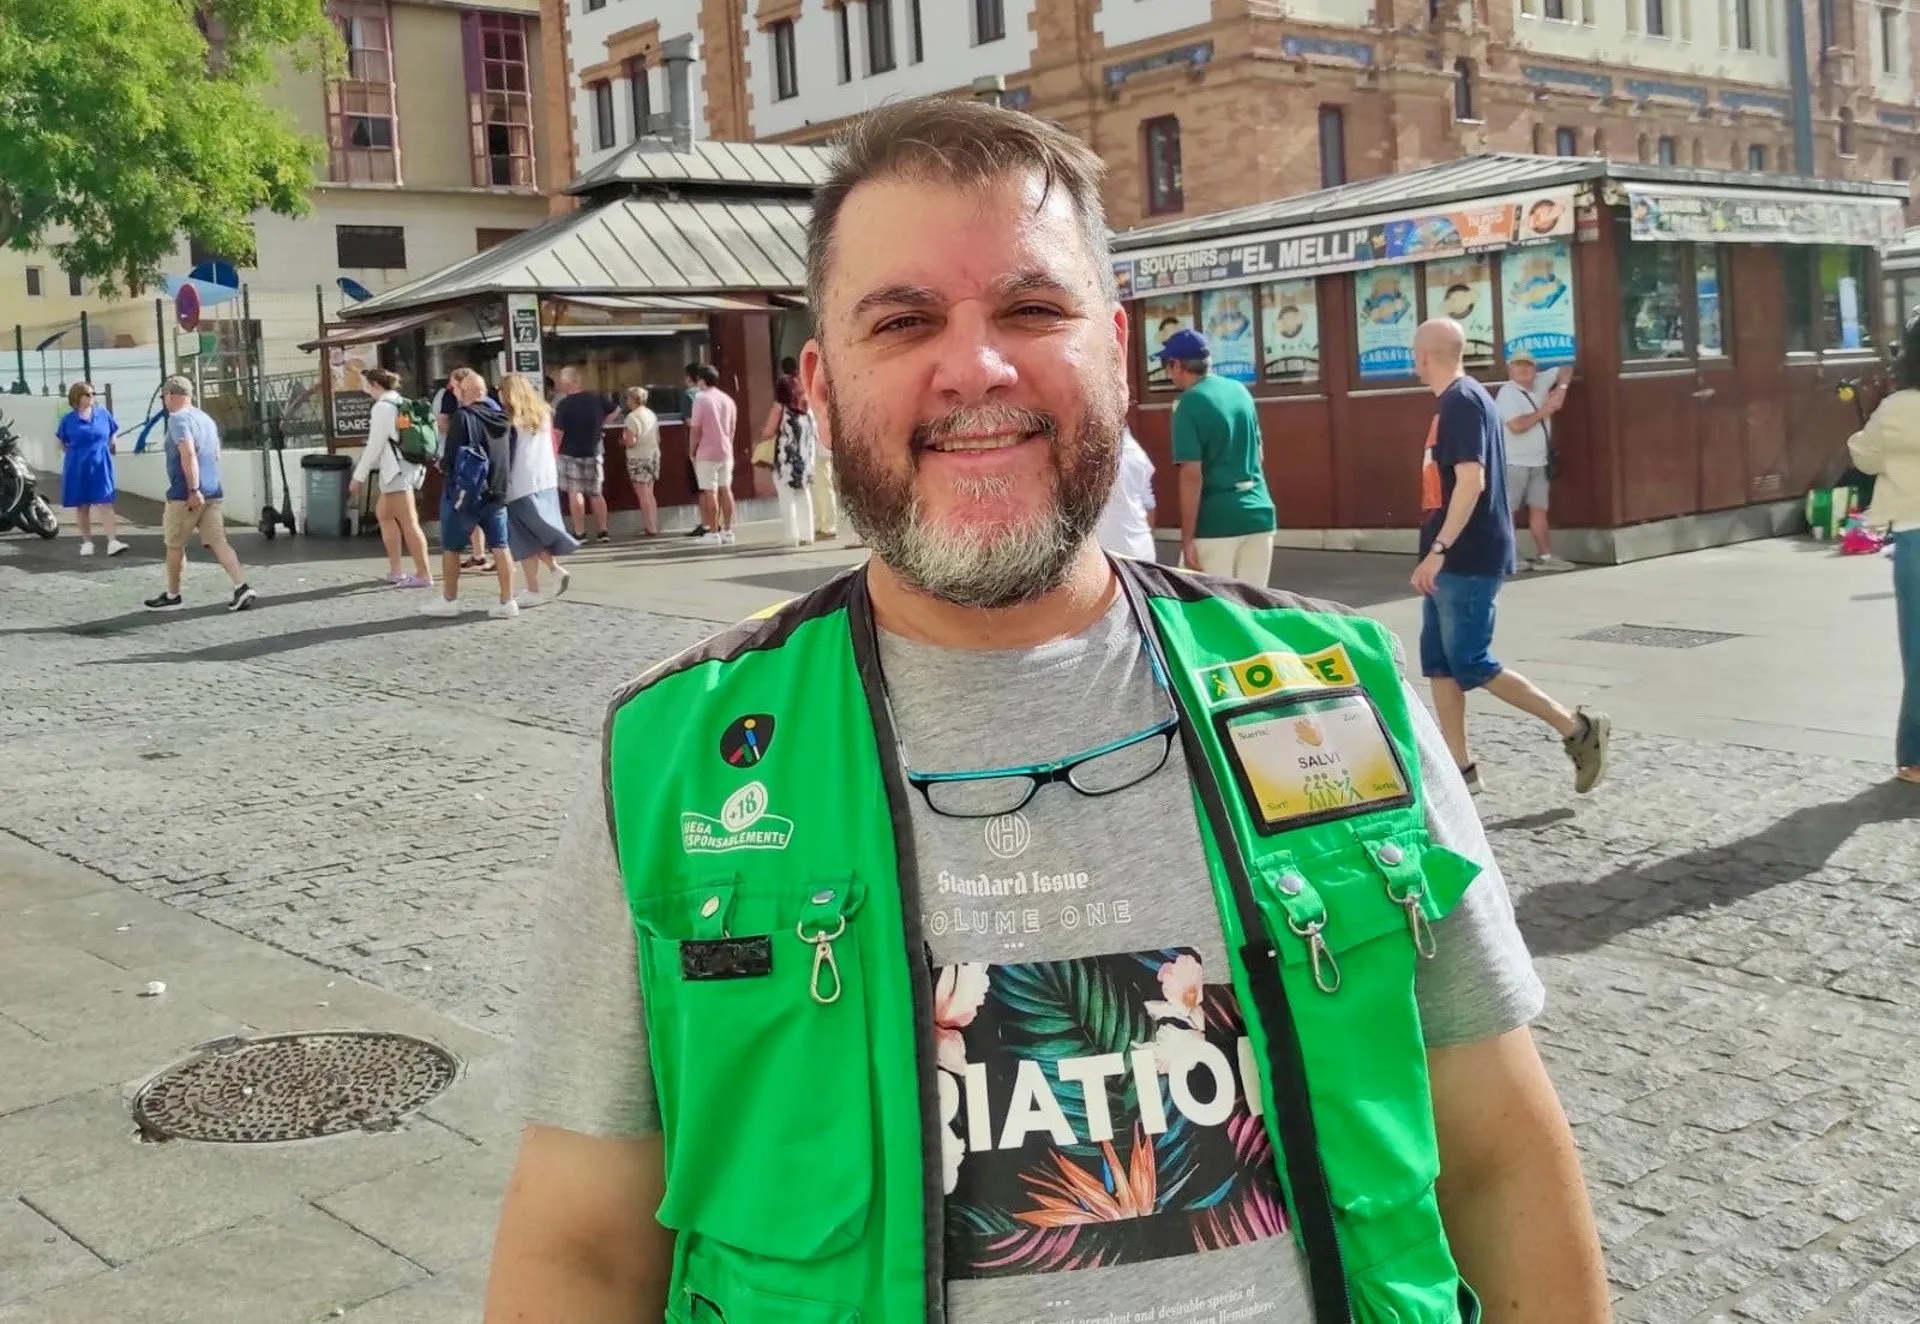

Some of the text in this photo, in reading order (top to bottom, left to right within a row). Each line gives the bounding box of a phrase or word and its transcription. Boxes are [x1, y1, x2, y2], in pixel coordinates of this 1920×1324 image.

[1140, 249, 1218, 276] SOUVENIRS
[338, 418, 371, 432] BARE
[1245, 657, 1344, 689] OE
[683, 821, 712, 834] EGA
[938, 870, 1090, 896] Standard Issue
[922, 899, 1132, 936] OLUME ONE
